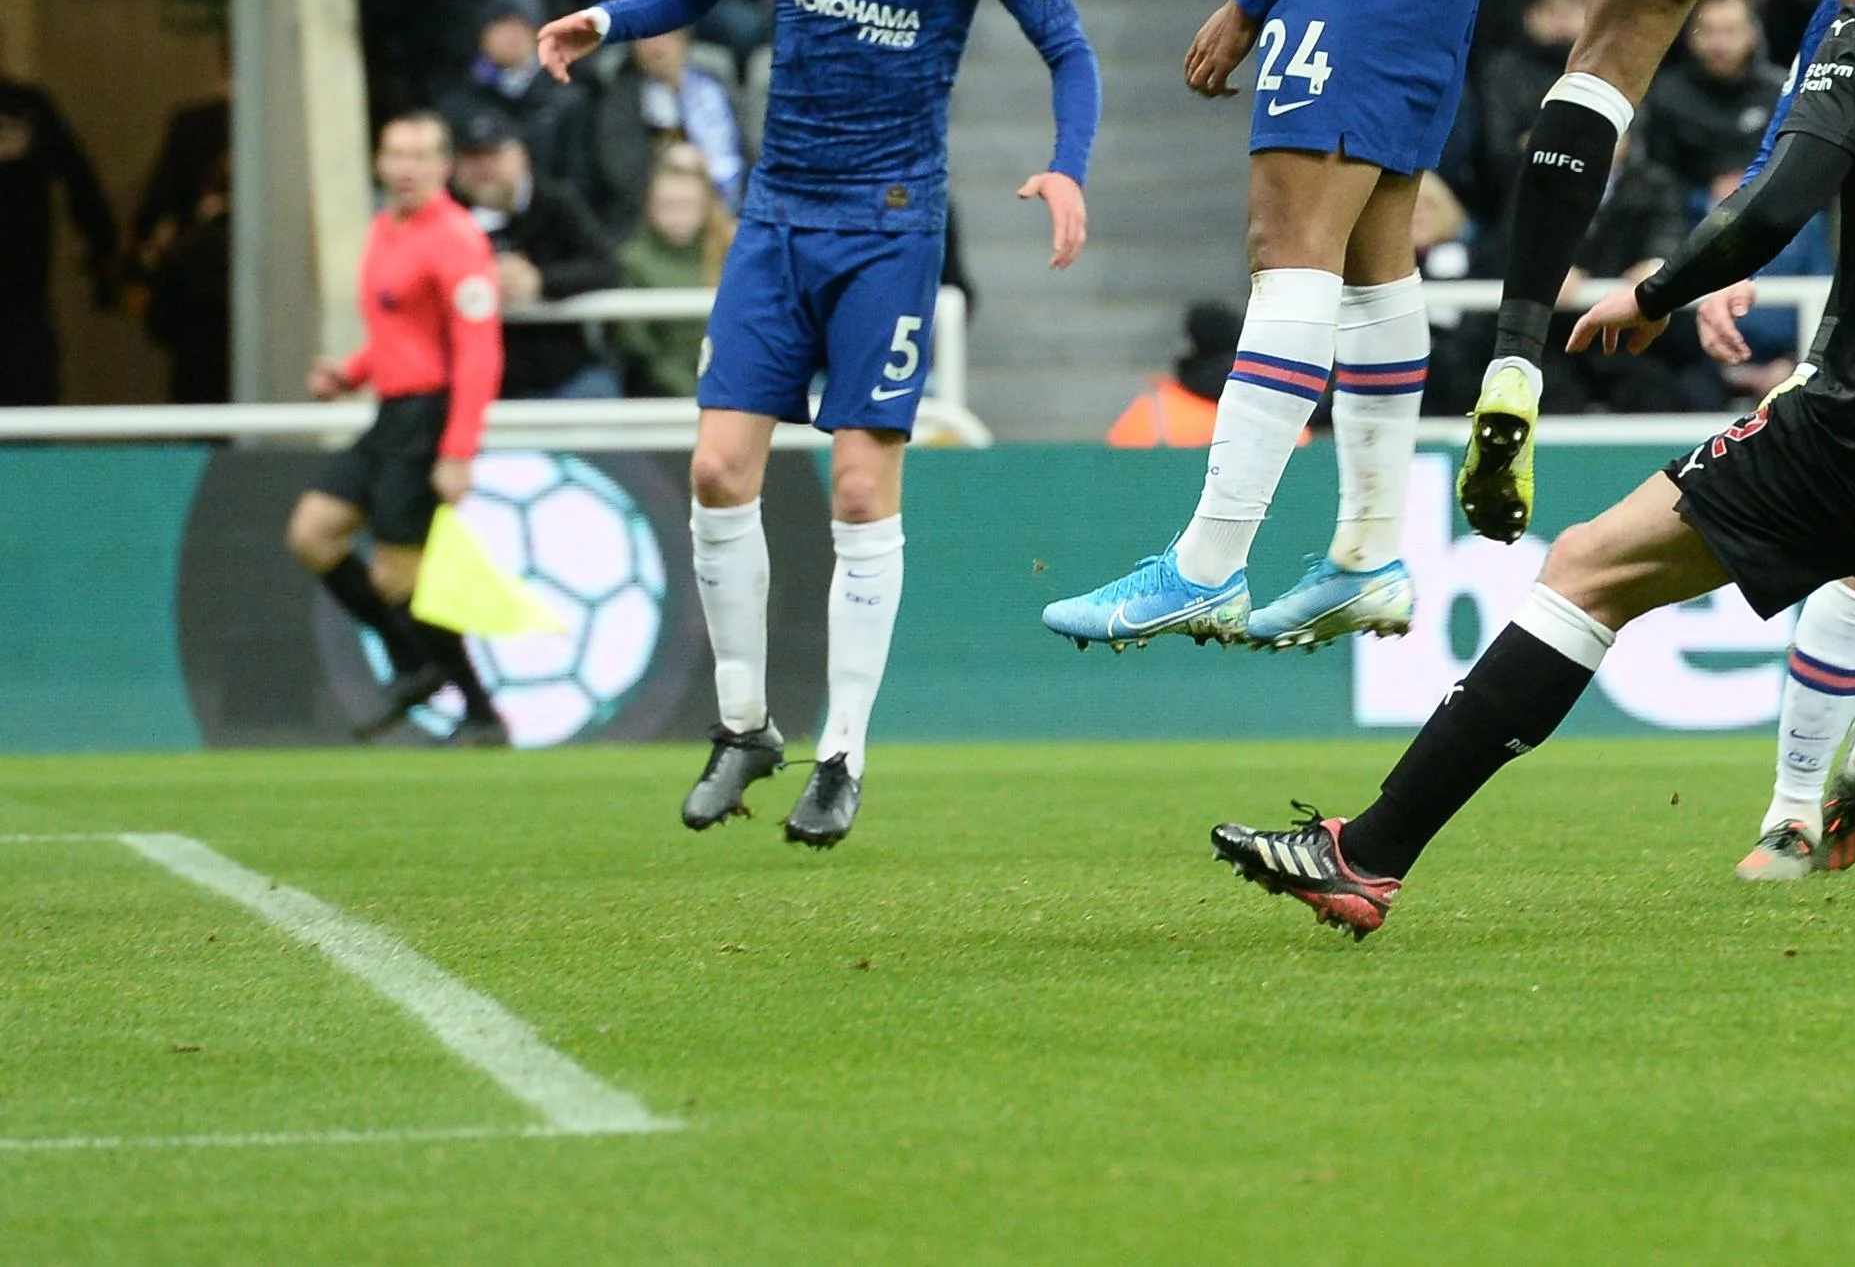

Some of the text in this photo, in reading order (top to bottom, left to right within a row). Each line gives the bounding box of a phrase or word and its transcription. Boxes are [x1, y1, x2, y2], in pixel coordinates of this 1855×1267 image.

[857, 26, 917, 48] TYRES
[1256, 18, 1333, 95] 24
[1532, 150, 1585, 174] NUFC
[883, 315, 923, 382] 5
[1711, 403, 1768, 458] 2
